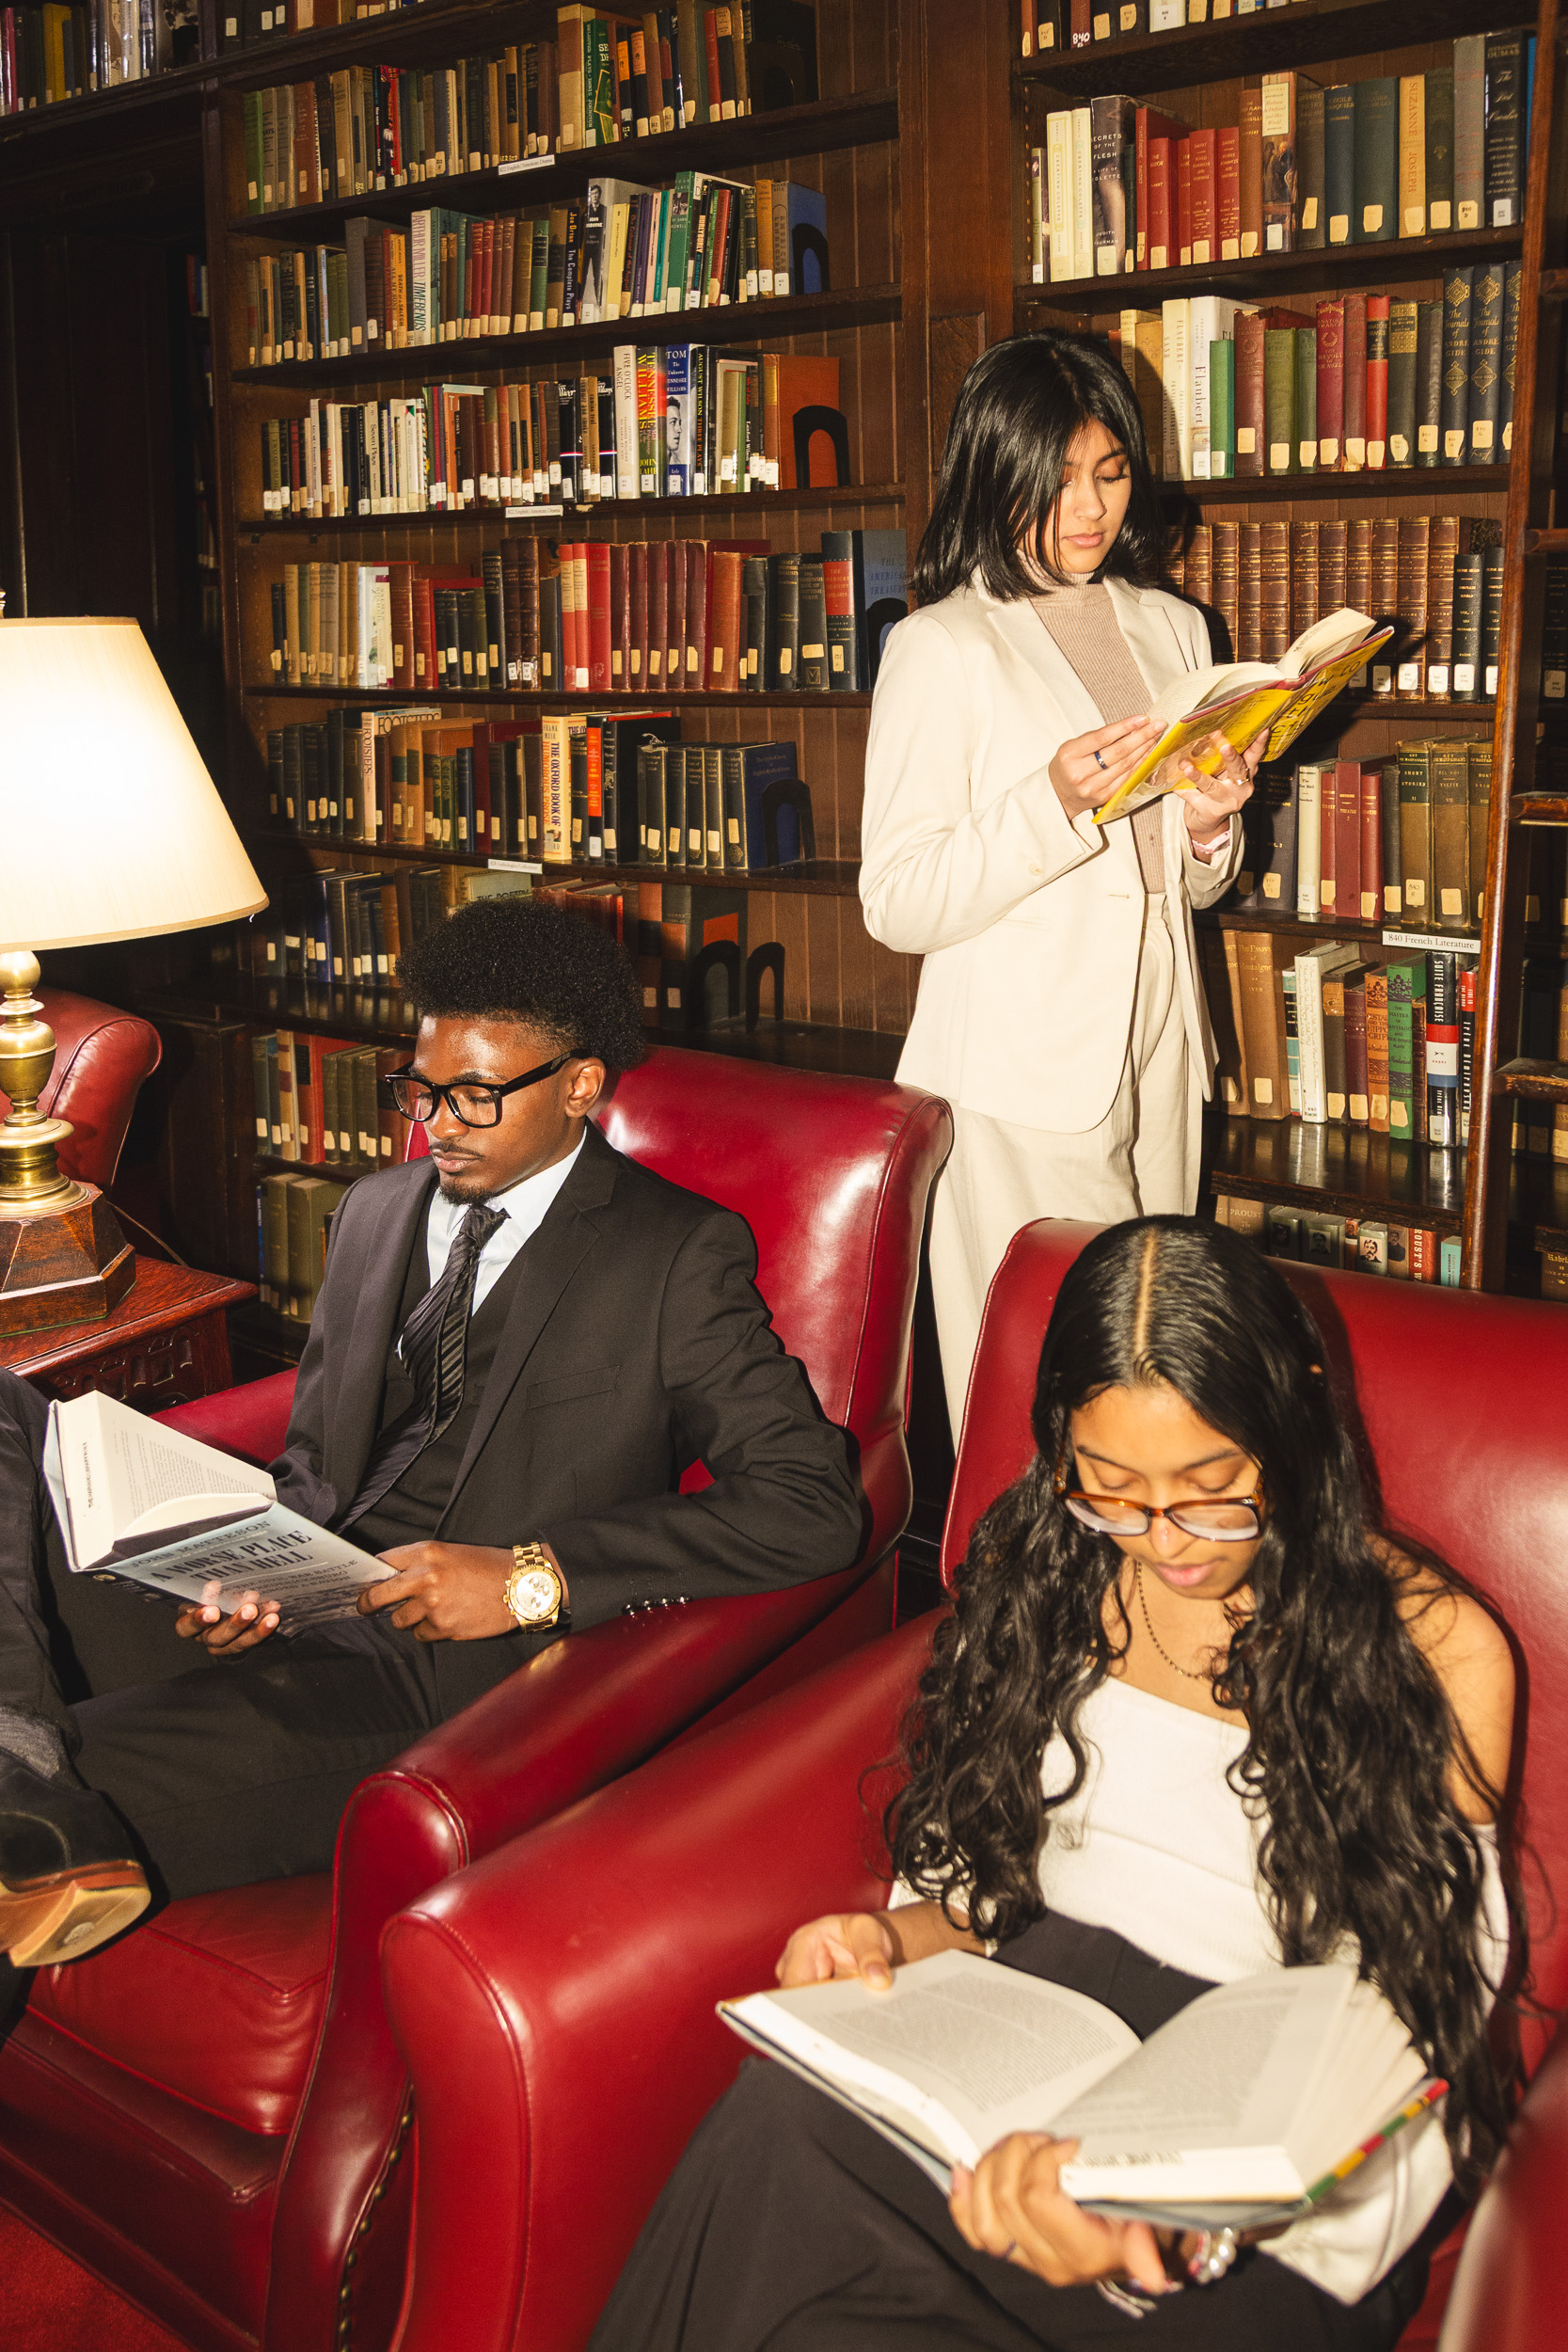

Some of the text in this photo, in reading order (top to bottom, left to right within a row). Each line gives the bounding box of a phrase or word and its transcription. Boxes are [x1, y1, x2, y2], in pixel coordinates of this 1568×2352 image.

[1072, 32, 1090, 44] 840
[1487, 49, 1520, 57] DUMAS
[1497, 71, 1513, 84] The
[1408, 82, 1418, 142] SUZANNE
[1092, 173, 1121, 183] COLETTE
[1408, 152, 1418, 193] JOSEPH
[568, 212, 578, 243] Joe Orton
[696, 215, 705, 253] HURLYBURLY
[413, 215, 426, 332] ARTHUR MILLER TIMEBENDS
[565, 249, 576, 310] The Complete Plays
[1449, 310, 1461, 318] The
[1480, 307, 1491, 316] The
[1445, 318, 1469, 328] Journals
[1474, 316, 1499, 326] Journals
[1452, 328, 1460, 337] of
[1481, 326, 1489, 336] of
[667, 350, 687, 358] TOM
[1475, 346, 1496, 355] GIDE
[637, 354, 647, 429] WILLIAMS
[646, 352, 657, 427] TENNESSEE
[1195, 365, 1206, 424] Flaubert
[363, 728, 373, 775] FOOTSTEPS
[551, 742, 562, 826] THE OXFORD BOOK OF
[1239, 944, 1273, 955] The Essays
[1387, 934, 1475, 949] 840 French Literature
[1239, 961, 1274, 973] Montaigne
[1433, 961, 1444, 1023] SUITE FRANÇAISE
[1230, 1209, 1262, 1218] PROUST
[1414, 1229, 1422, 1268] ROUST'S
[133, 1520, 271, 1568] JOHN MATTESON
[150, 1530, 313, 1583] A WORSE PLACE
[189, 1549, 314, 1581] THAN HELL
[313, 1559, 358, 1575] BATTLE
